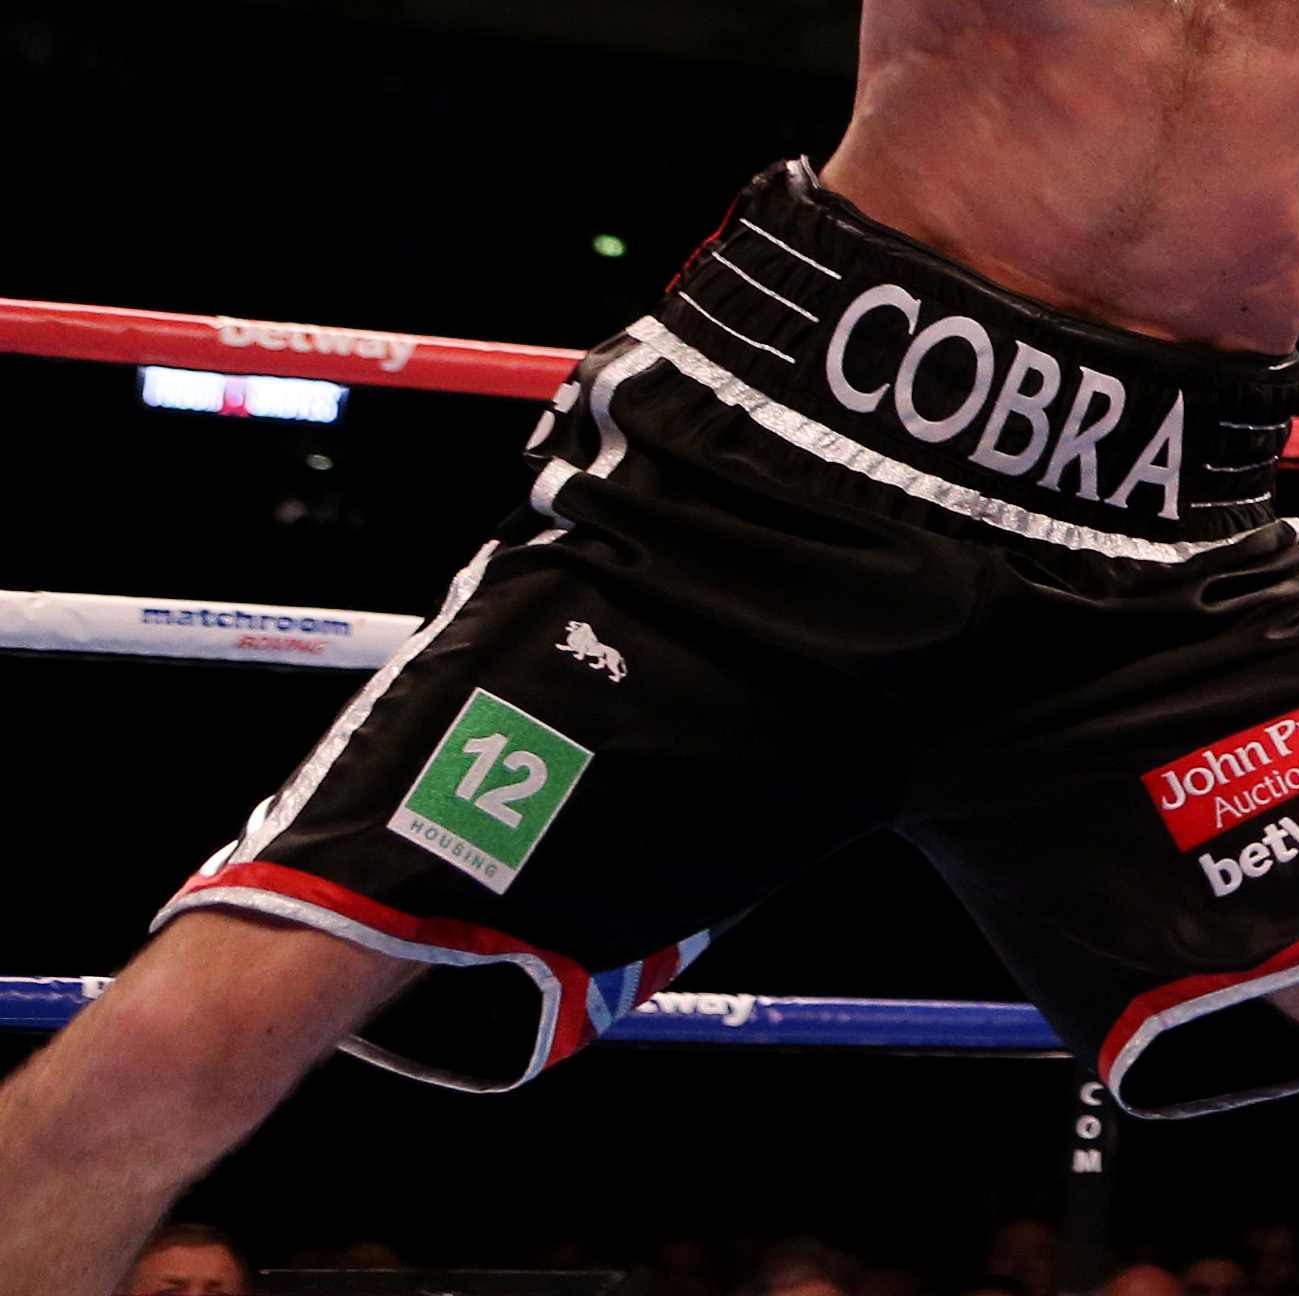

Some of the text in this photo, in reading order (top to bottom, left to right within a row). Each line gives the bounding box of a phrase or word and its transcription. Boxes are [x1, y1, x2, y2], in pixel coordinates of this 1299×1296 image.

[826, 283, 1185, 520] COBRA
[143, 608, 350, 636] matchroom
[455, 733, 548, 829] 12
[1161, 741, 1271, 811] John
[410, 819, 498, 878] HOUSING
